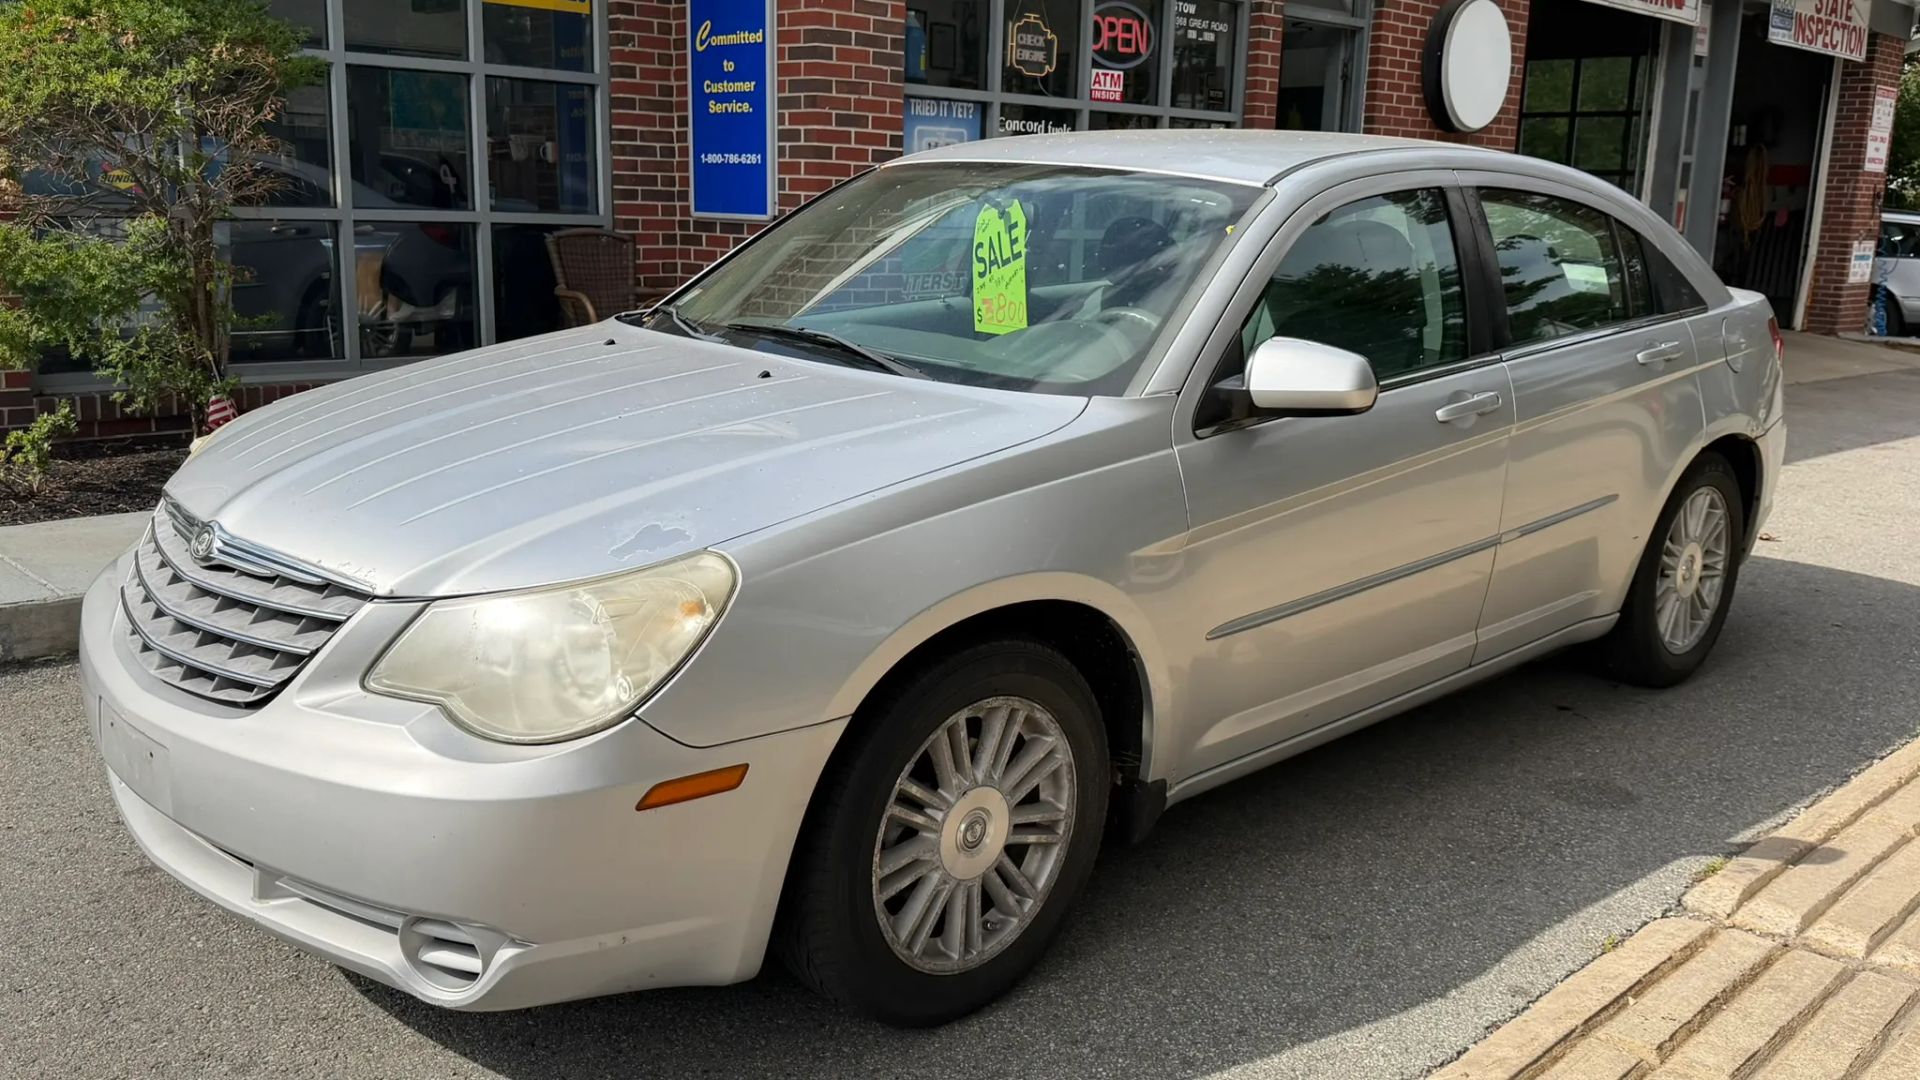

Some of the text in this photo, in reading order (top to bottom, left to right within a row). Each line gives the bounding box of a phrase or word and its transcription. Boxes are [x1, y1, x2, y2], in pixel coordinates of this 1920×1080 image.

[1188, 17, 1210, 30] GREAT
[1210, 21, 1229, 33] ROAD
[695, 20, 764, 52] Committed
[1016, 32, 1046, 48] CHECK
[1092, 14, 1148, 56] OPEN
[1793, 11, 1866, 57] INSPECTION
[1016, 49, 1047, 64] ENGINE
[723, 59, 734, 72] to
[703, 80, 756, 95] Customer
[1092, 71, 1122, 89] ATM
[1091, 90, 1121, 101] INSIDE
[708, 100, 753, 114] Service.
[909, 98, 975, 119] TRIED IT YET?
[999, 116, 1046, 134] Concord
[700, 153, 762, 165] 1-800-786-6261
[975, 221, 1023, 279] SALE
